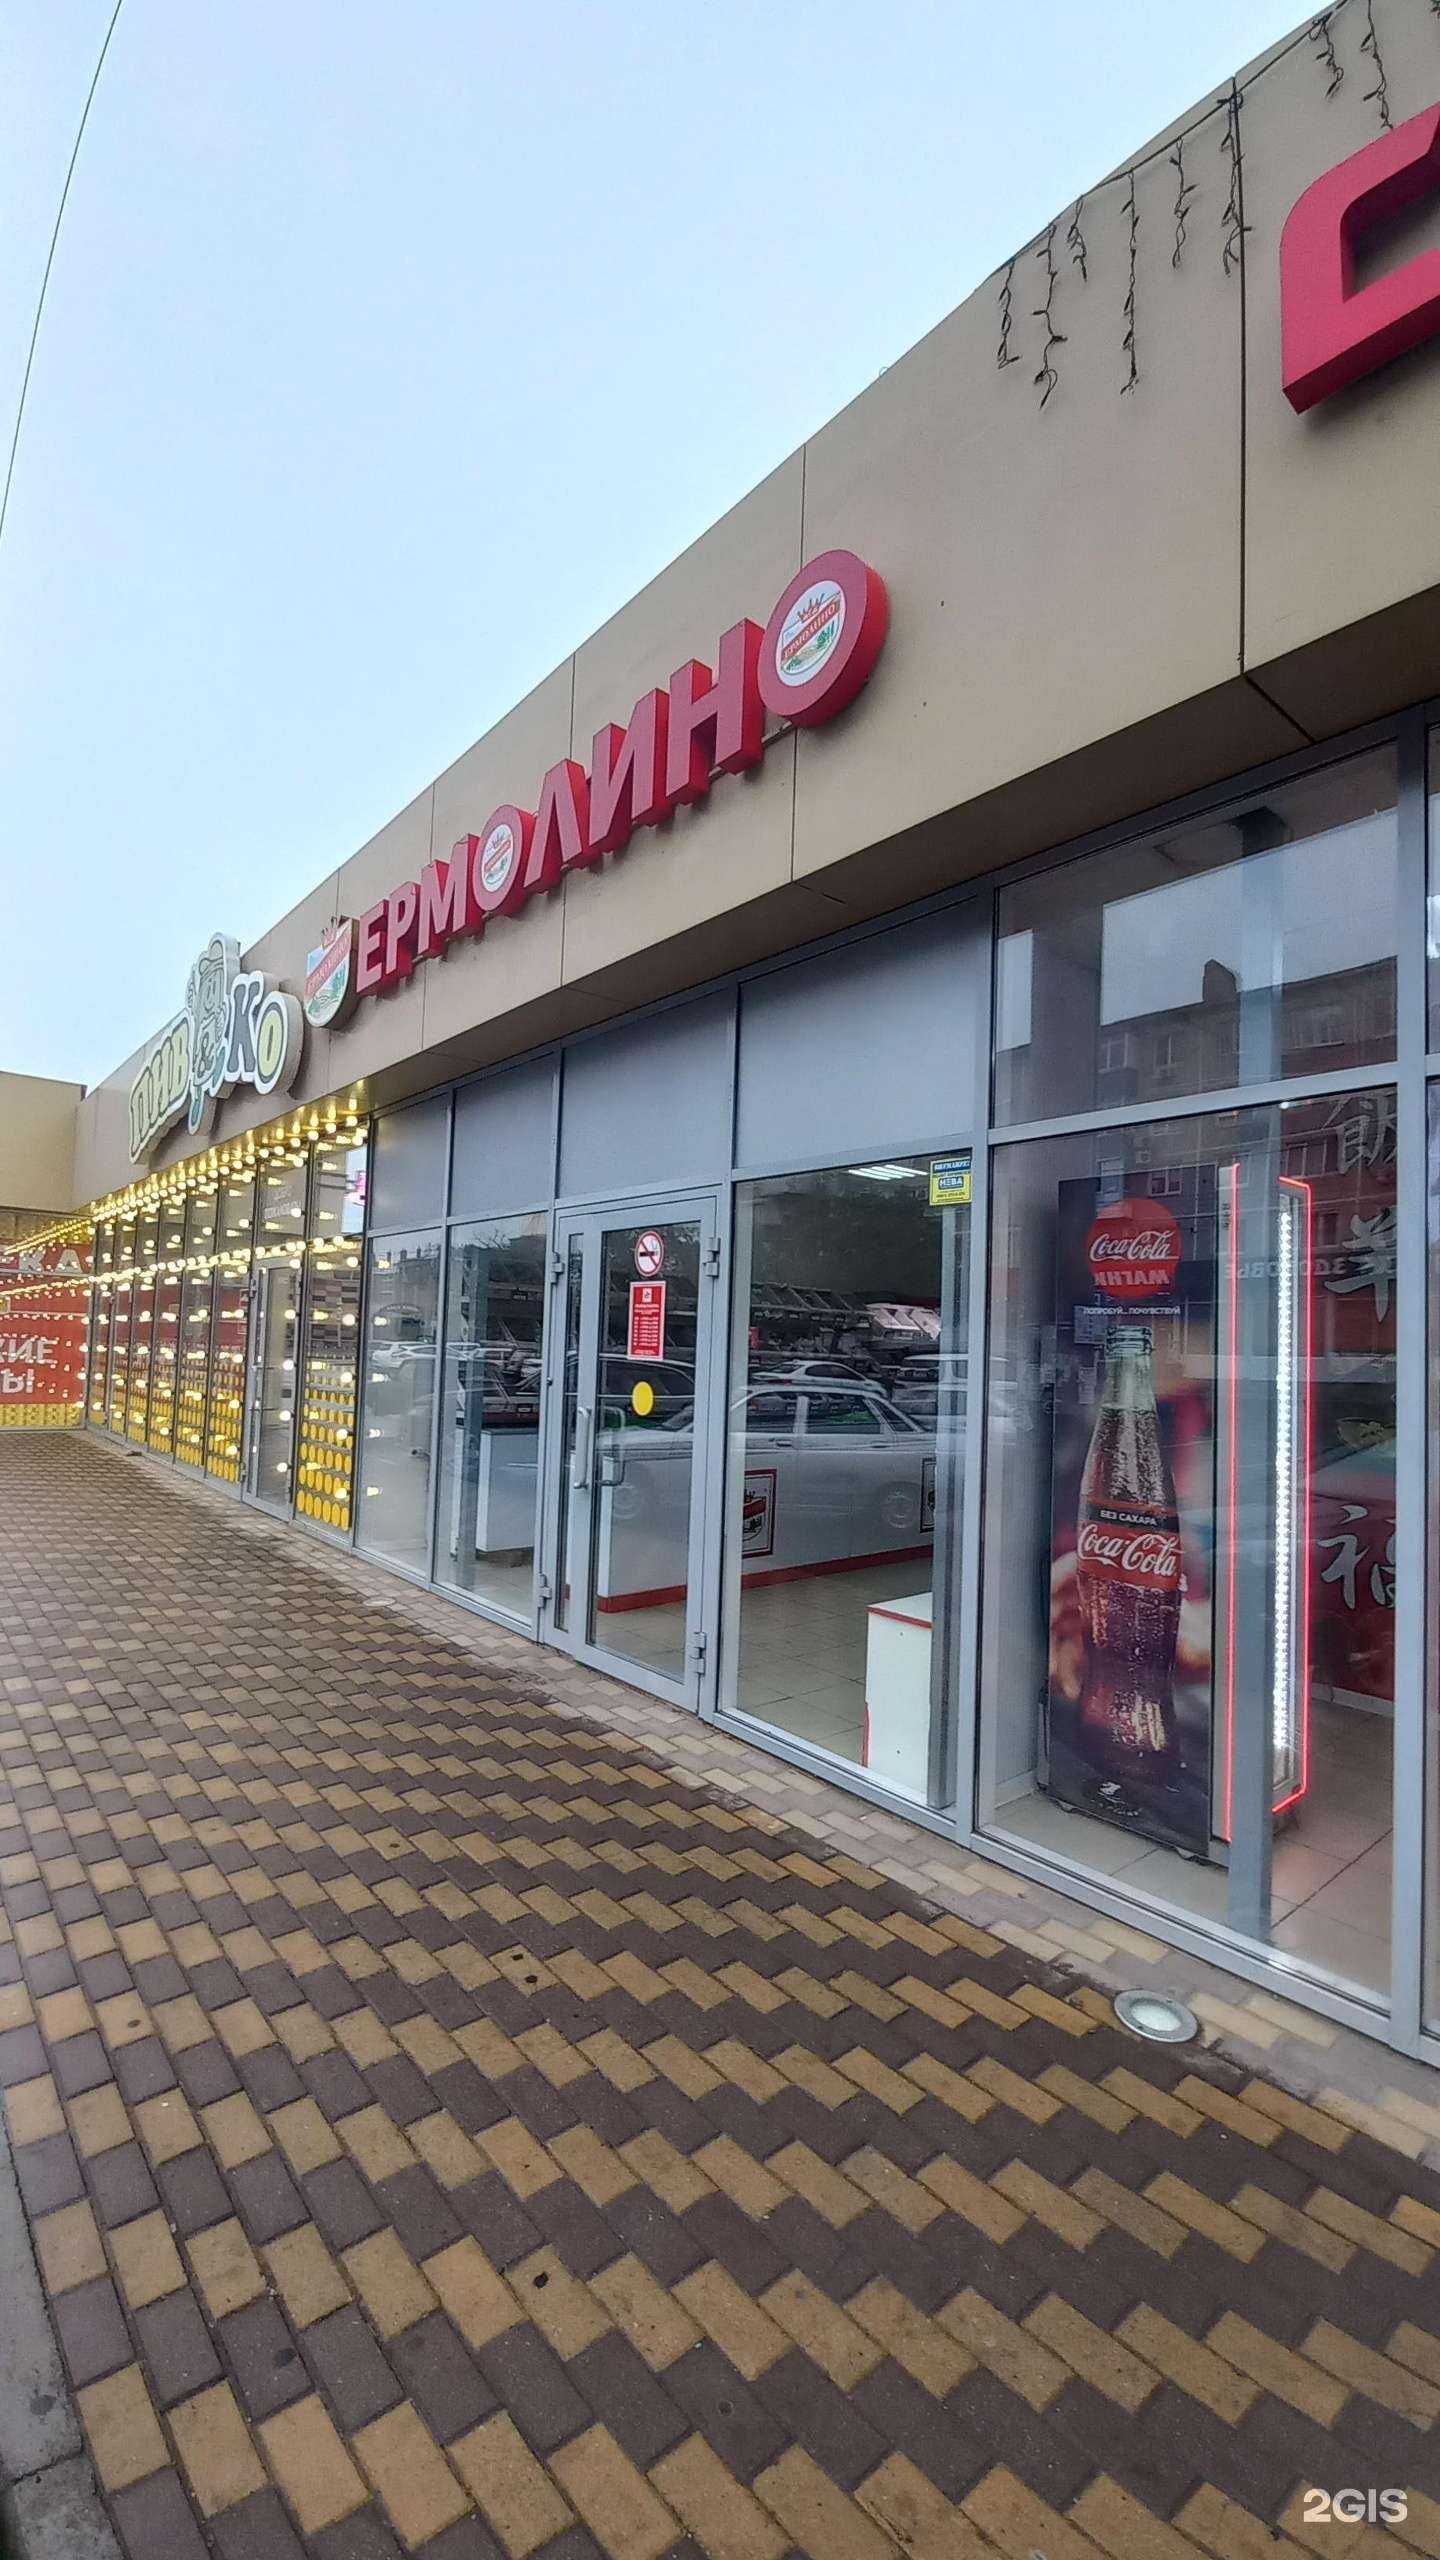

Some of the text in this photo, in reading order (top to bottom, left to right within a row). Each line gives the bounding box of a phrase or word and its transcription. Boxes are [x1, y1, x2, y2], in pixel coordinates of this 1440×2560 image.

[356, 549, 882, 994] ЕРМОЛИНО
[1089, 1230, 1179, 1262] Coca-Cola
[1119, 1512, 1158, 1526] САХАРА
[1078, 1523, 1184, 1577] Coca-Cola
